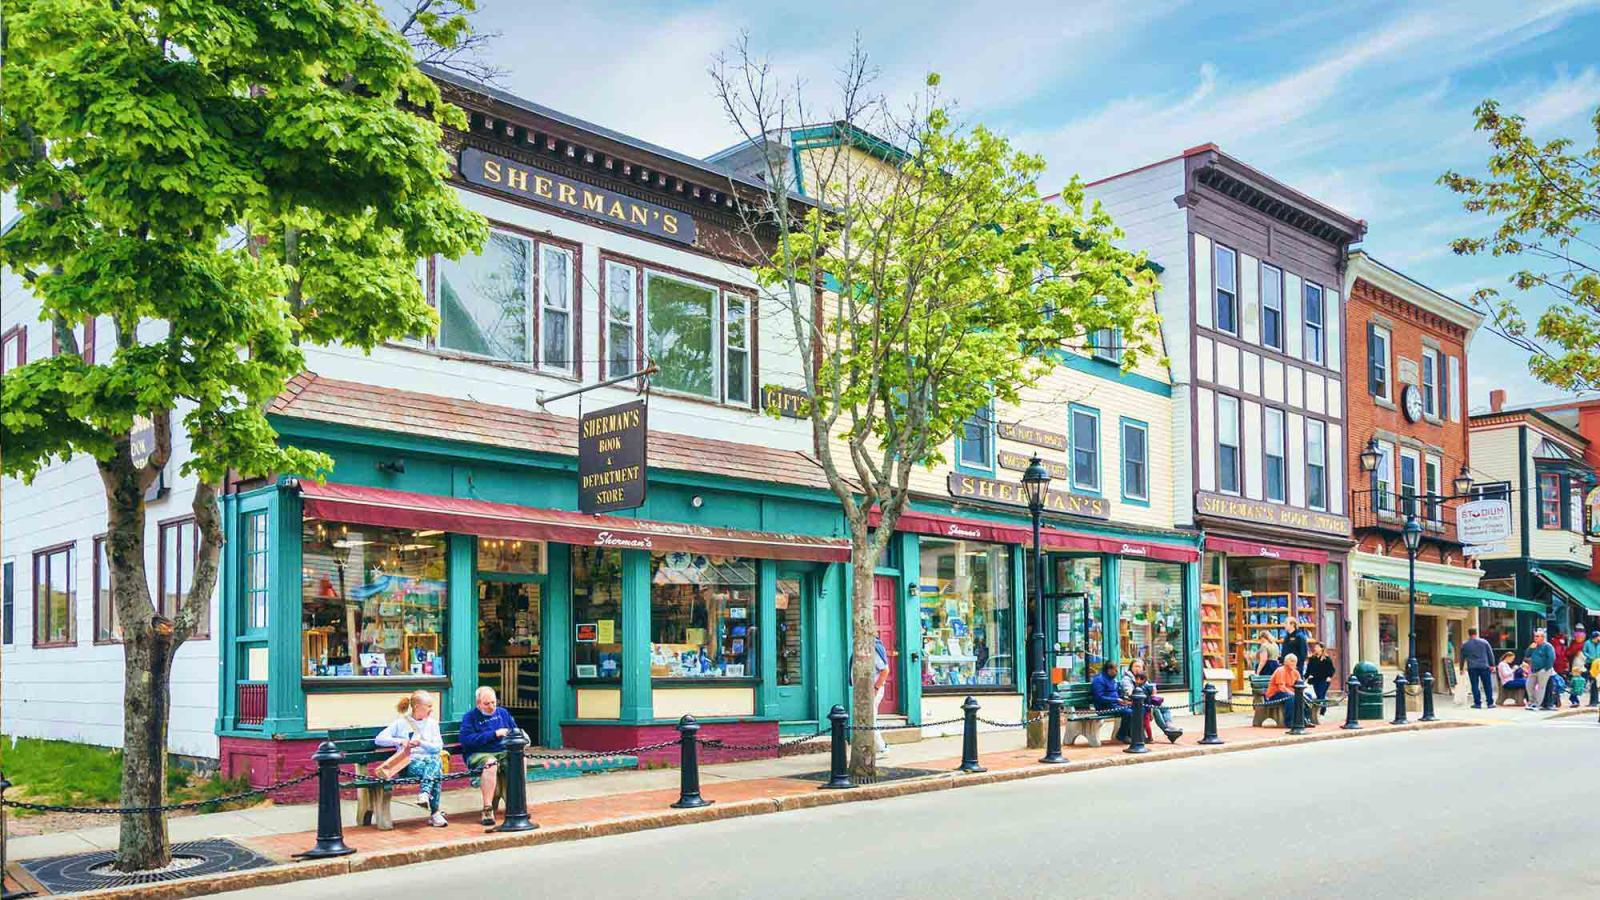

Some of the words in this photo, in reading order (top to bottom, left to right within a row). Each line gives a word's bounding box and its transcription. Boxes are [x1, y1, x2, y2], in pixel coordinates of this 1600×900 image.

[483, 160, 679, 234] SHERMAN'S
[583, 408, 640, 439] SHERMAN'S
[599, 436, 621, 452] BOOK
[583, 466, 639, 489] DEPARTMENT
[596, 488, 624, 504] STORE
[961, 477, 1102, 515] SHERAN'S
[1203, 497, 1274, 520] SHERMAN'S
[1280, 510, 1309, 528] BOOK
[594, 531, 653, 548] Sherman's
